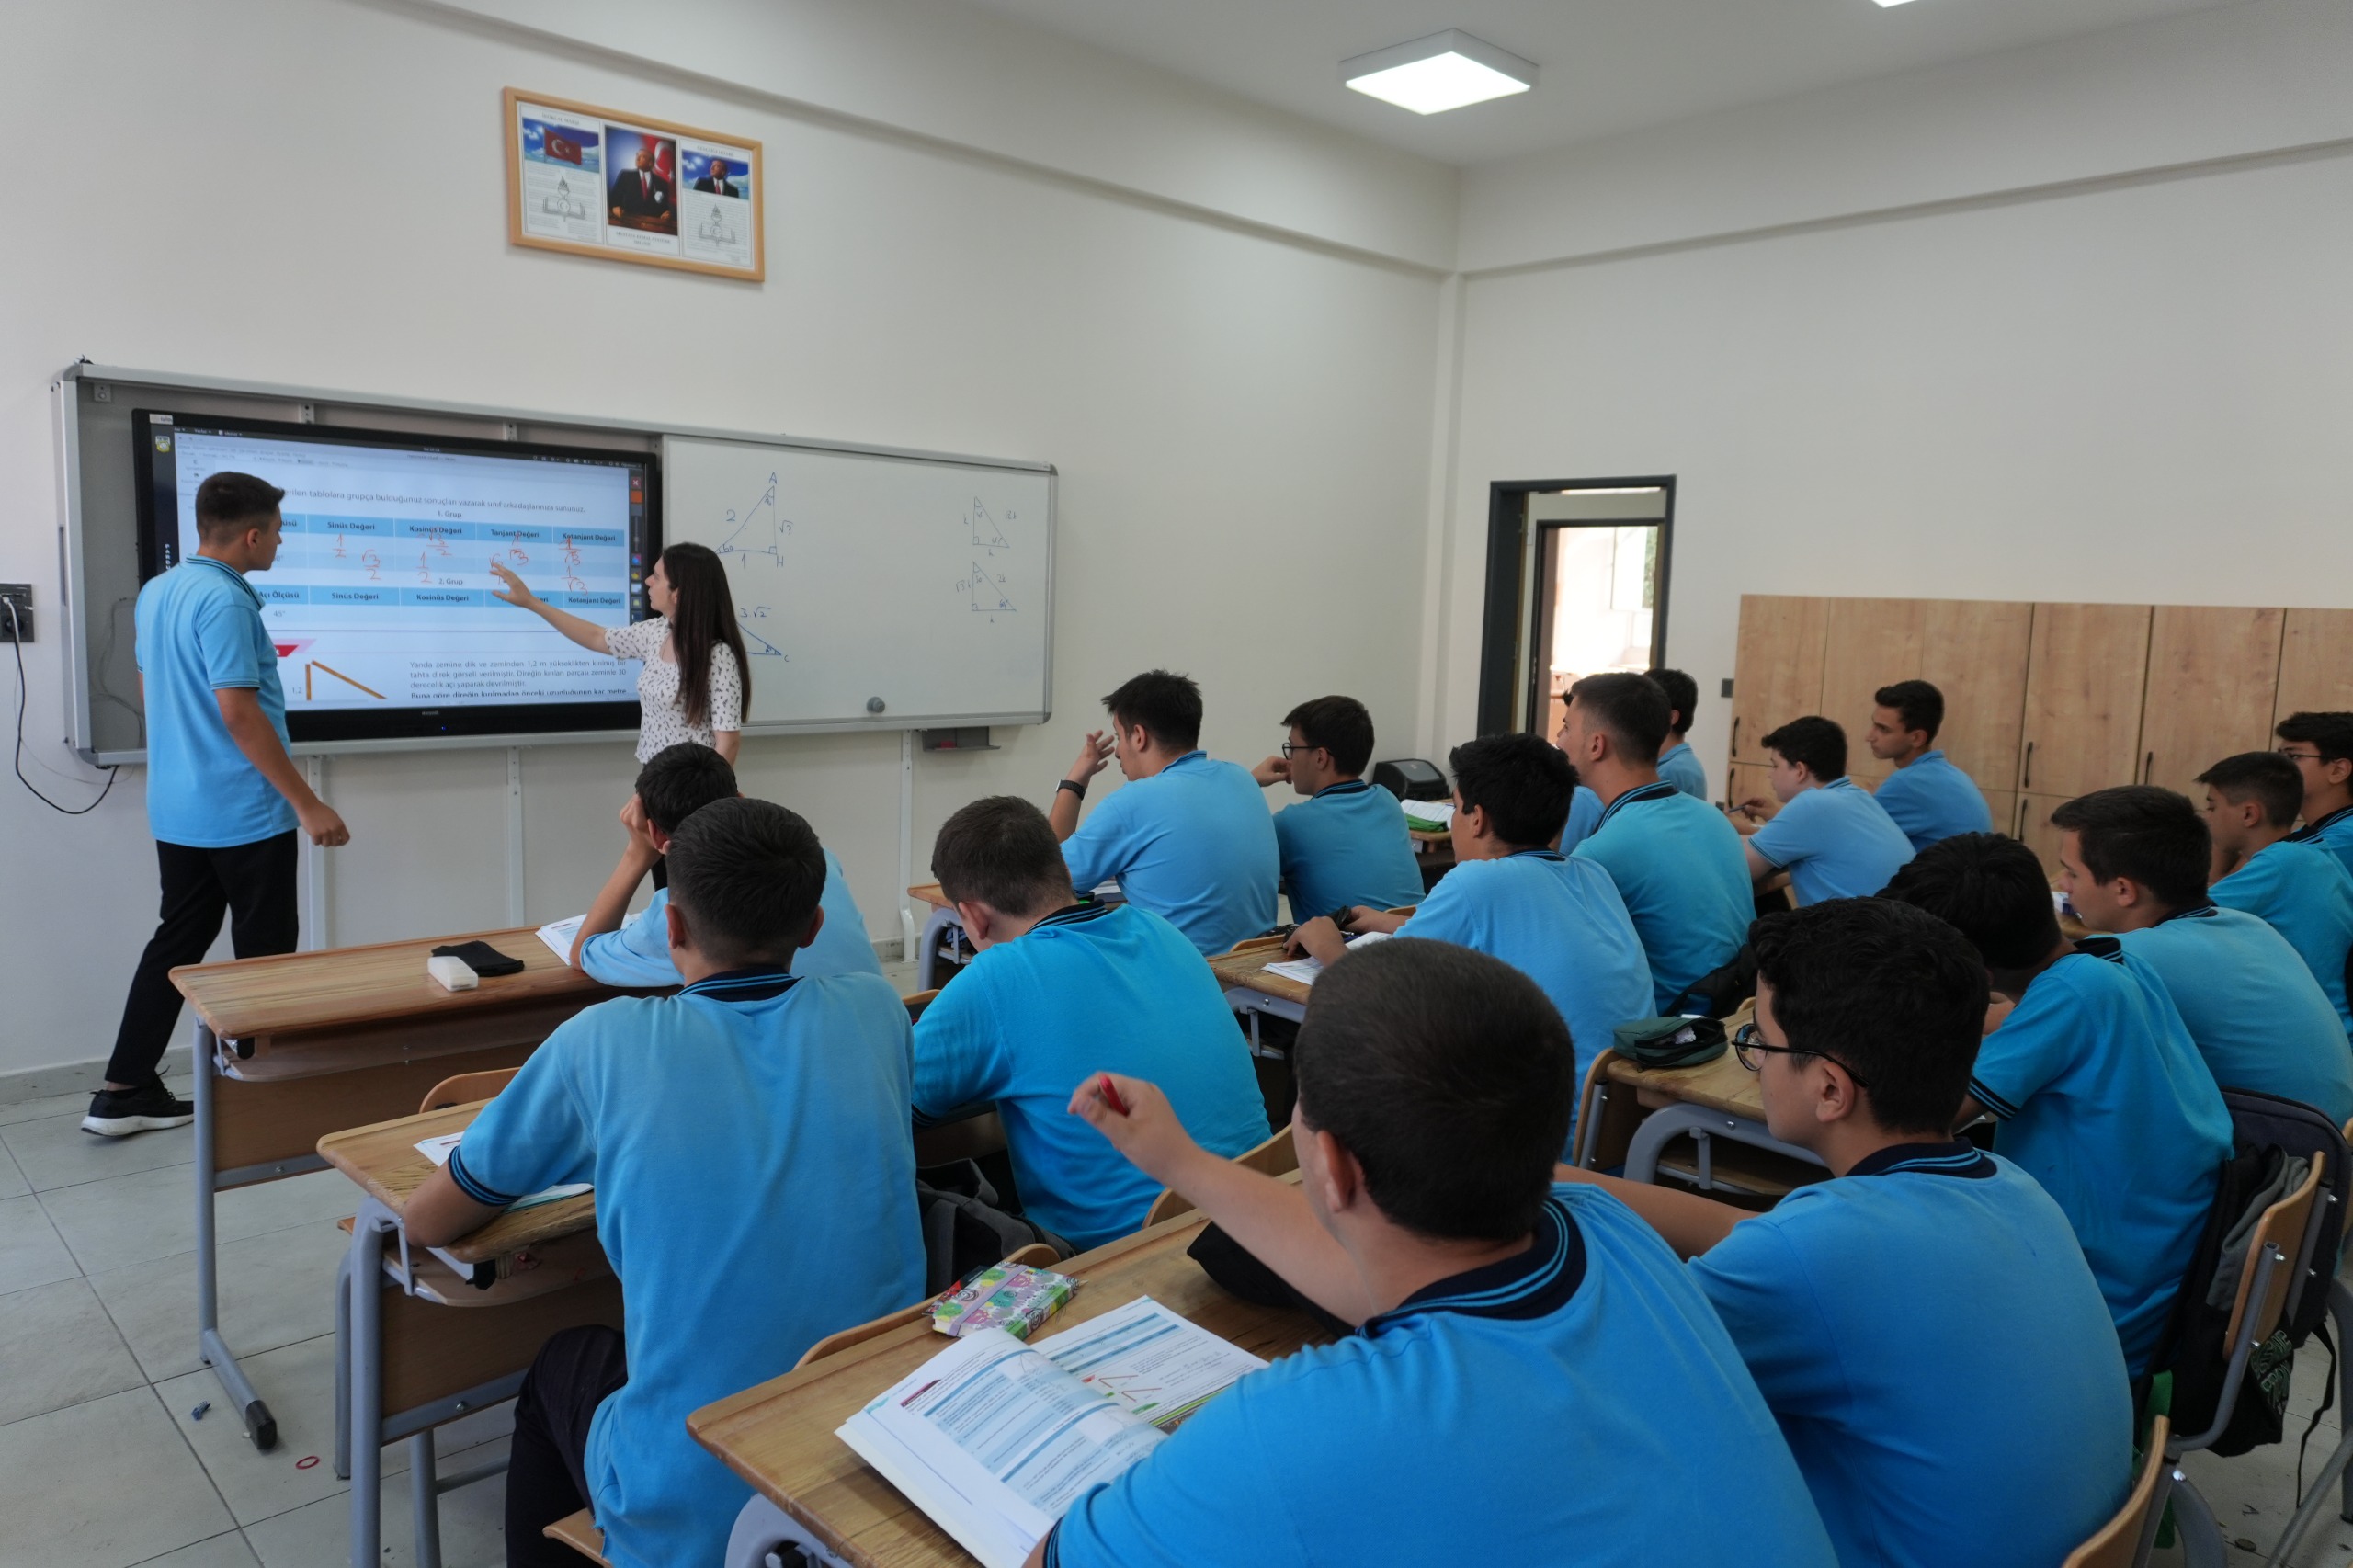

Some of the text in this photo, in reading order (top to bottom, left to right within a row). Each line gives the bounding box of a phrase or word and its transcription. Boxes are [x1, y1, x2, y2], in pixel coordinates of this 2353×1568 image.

[768, 471, 778, 485] A
[309, 490, 345, 499] tablolara
[347, 494, 374, 502] grupça
[376, 493, 422, 505] bulduğunuz
[459, 499, 485, 507] yazarak
[445, 510, 462, 518] Grup
[726, 509, 736, 522] 2
[327, 521, 375, 531] Sinüs Değeri
[409, 525, 462, 536] Kosinüs Değeri
[491, 528, 540, 539] Tanjant Değeri
[563, 533, 616, 542] Kotanjant Değeri
[776, 555, 784, 569] H
[259, 591, 300, 600] Açı Ölçüsü
[354, 593, 379, 601] Değeri
[446, 594, 469, 603] Değeri
[600, 597, 621, 606] Değeri
[465, 660, 476, 668] dik
[550, 659, 590, 667] yükseklikten
[453, 670, 477, 679] görseli
[517, 669, 542, 678] Direğin
[566, 669, 589, 677] parçası
[591, 668, 617, 676] zeminle
[410, 680, 443, 688] derecelik
[457, 680, 485, 689] yaparak
[486, 679, 527, 688] devrilmiştir.
